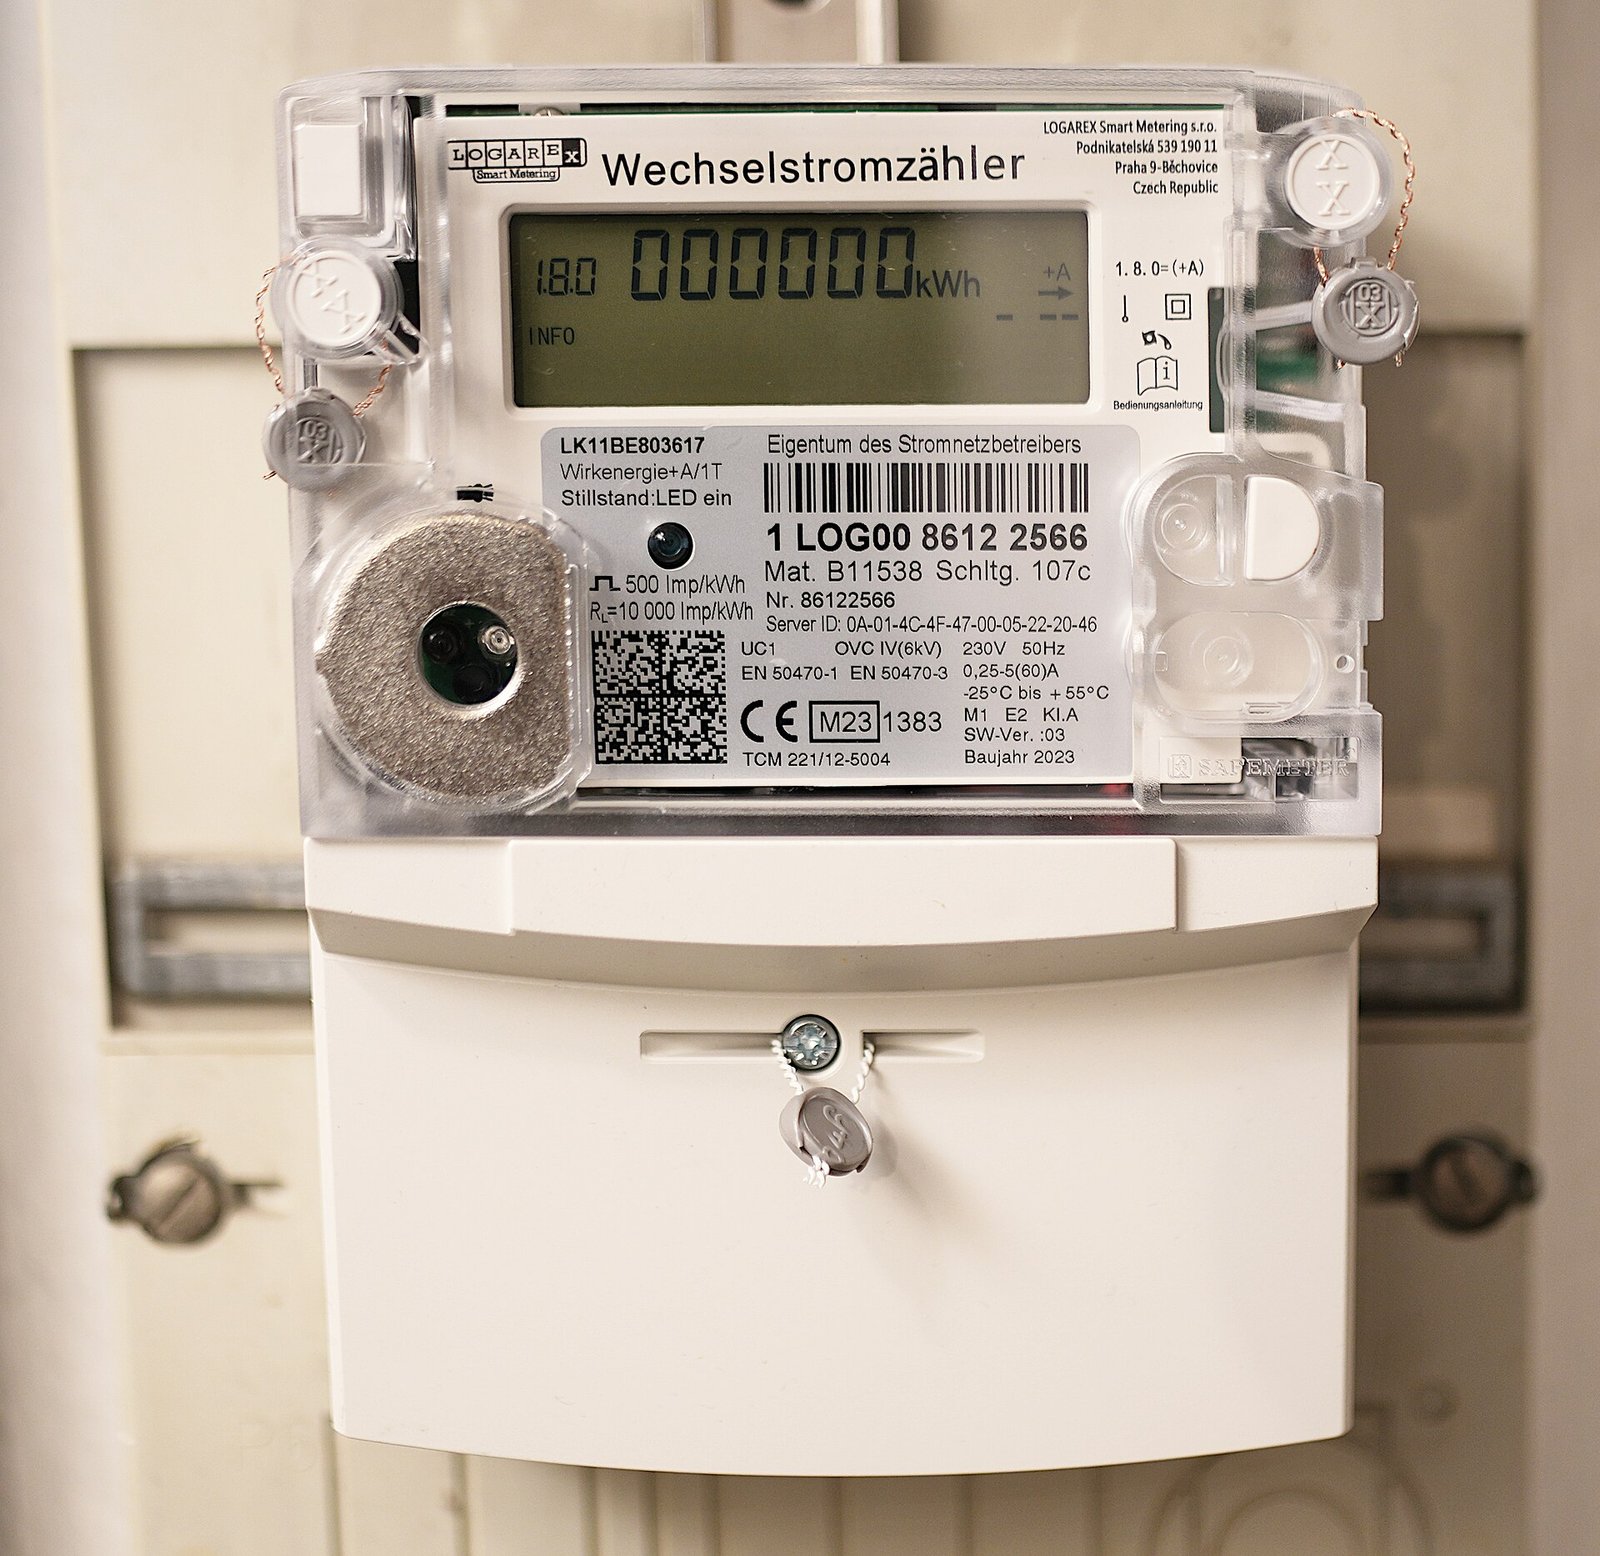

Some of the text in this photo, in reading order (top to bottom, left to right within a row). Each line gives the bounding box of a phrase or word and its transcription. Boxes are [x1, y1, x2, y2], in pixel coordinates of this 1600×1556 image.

[1044, 119, 1217, 136] LOGAREX Smart Metering s.r.o.
[452, 143, 580, 164] LOGAREX
[1077, 139, 1218, 155] Podnikatelská 539 190 11
[602, 145, 1025, 186] Wechselstromzähler
[1115, 160, 1218, 174] Praha 9-Běchovice
[476, 169, 556, 180] Smart Metering
[1133, 180, 1219, 197] Czech Republic
[631, 227, 981, 301] 000000 kWh
[1357, 283, 1383, 301] 03
[528, 327, 575, 345] INFO
[1113, 401, 1203, 411] Bedienungsanleitung
[560, 437, 705, 454] LK11BE803617
[767, 434, 1081, 457] Eigentum des Stromnetzbetreibers
[560, 463, 722, 484] Wirkenergie+A/1T
[561, 489, 732, 506] Stillstand:LED ein
[767, 522, 1088, 551] 1 LOG00 8612 2566
[765, 560, 1091, 585] Mat. B11538 Schltg. 107c
[626, 574, 746, 598] 500 Imp/kWh
[766, 591, 896, 608] Nr. 86122566
[645, 602, 675, 620] 000
[681, 601, 754, 625] Imp/kWh
[767, 615, 1098, 632] Server ID: 0A-01-4C-4F-47-00-05-22-20-46
[741, 641, 775, 655] UC1
[835, 641, 941, 659] OVC IV(6kV)
[963, 641, 1066, 655] 230V 50Hz
[742, 666, 837, 680] EN 50470-1
[851, 666, 948, 680] EN 50470-3
[963, 664, 1059, 681] 0,25-5(60)A
[964, 686, 1012, 700] -25°C
[1018, 686, 1042, 700] bis
[820, 711, 872, 732] M23
[883, 711, 942, 732] 1383
[964, 707, 987, 722] M1
[1006, 707, 1028, 722] E2
[742, 752, 891, 767] TCM 221/12-5004
[965, 749, 1075, 767] Baujahr 2023
